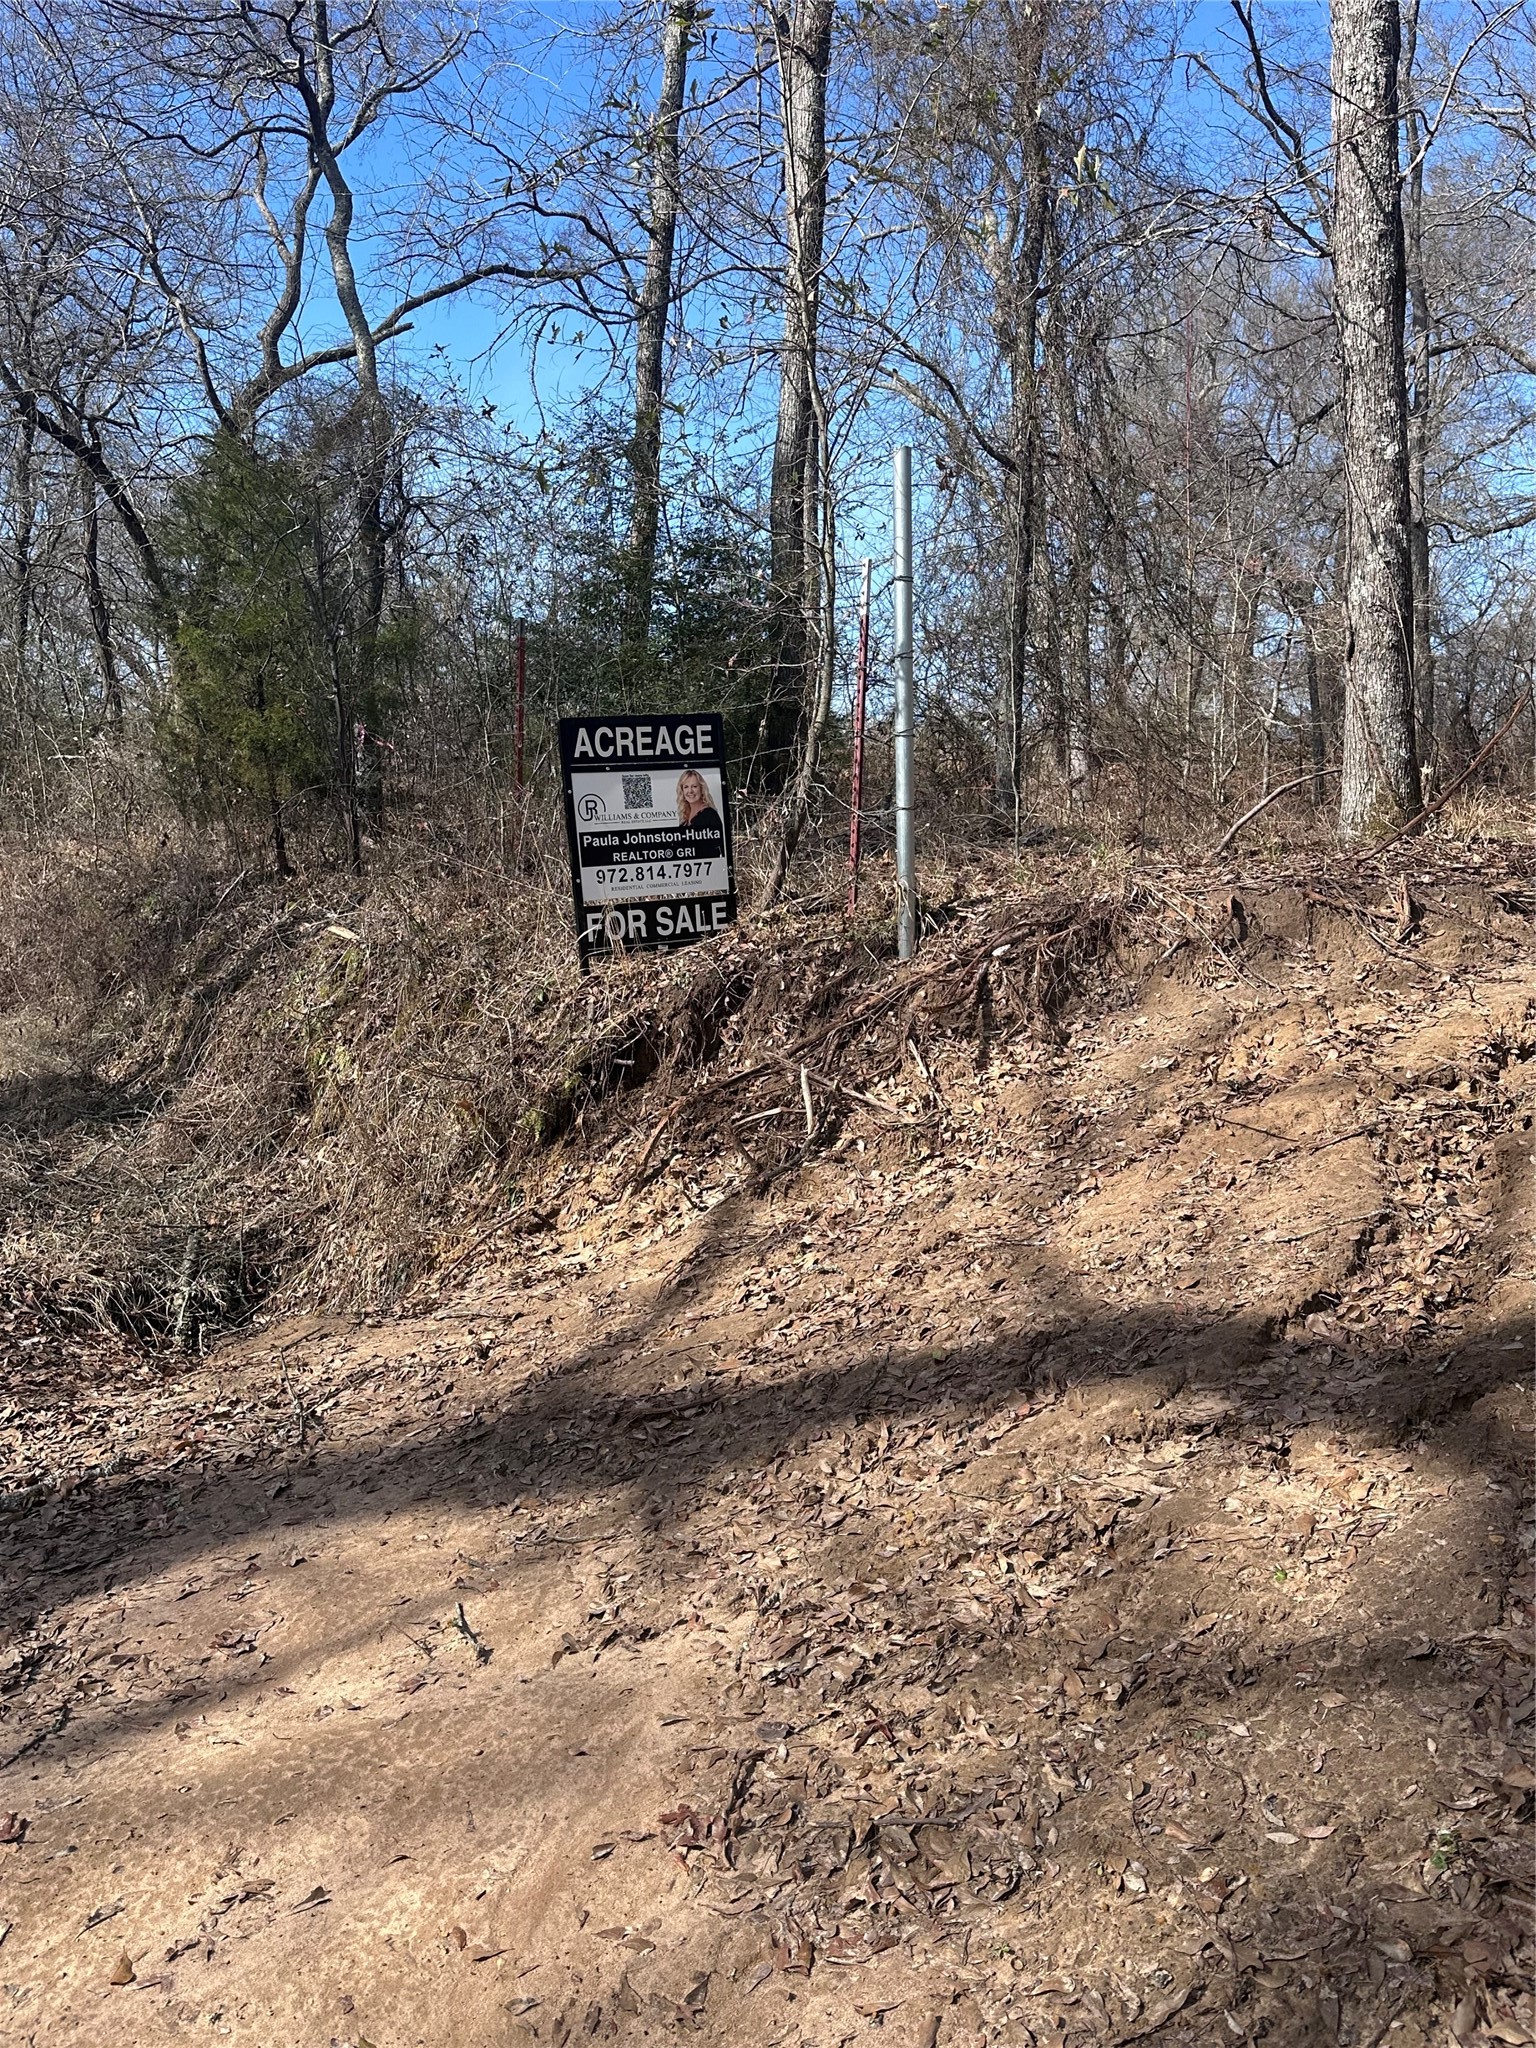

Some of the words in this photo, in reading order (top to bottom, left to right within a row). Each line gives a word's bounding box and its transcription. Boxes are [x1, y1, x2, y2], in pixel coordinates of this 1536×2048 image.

[574, 725, 714, 758] ACREAGE
[594, 812, 633, 822] WILLIAMS
[633, 812, 641, 820] &
[641, 810, 678, 820] COMPANY
[583, 833, 620, 848] Paula
[623, 828, 721, 846] Johnston-Hutka
[676, 847, 696, 858] GRI
[596, 861, 713, 885] 972.814.7977
[611, 884, 644, 892] RESIDENTIAL
[646, 881, 680, 889] COMMERCIAL
[586, 909, 648, 943] FOR
[655, 901, 729, 937] SALE
